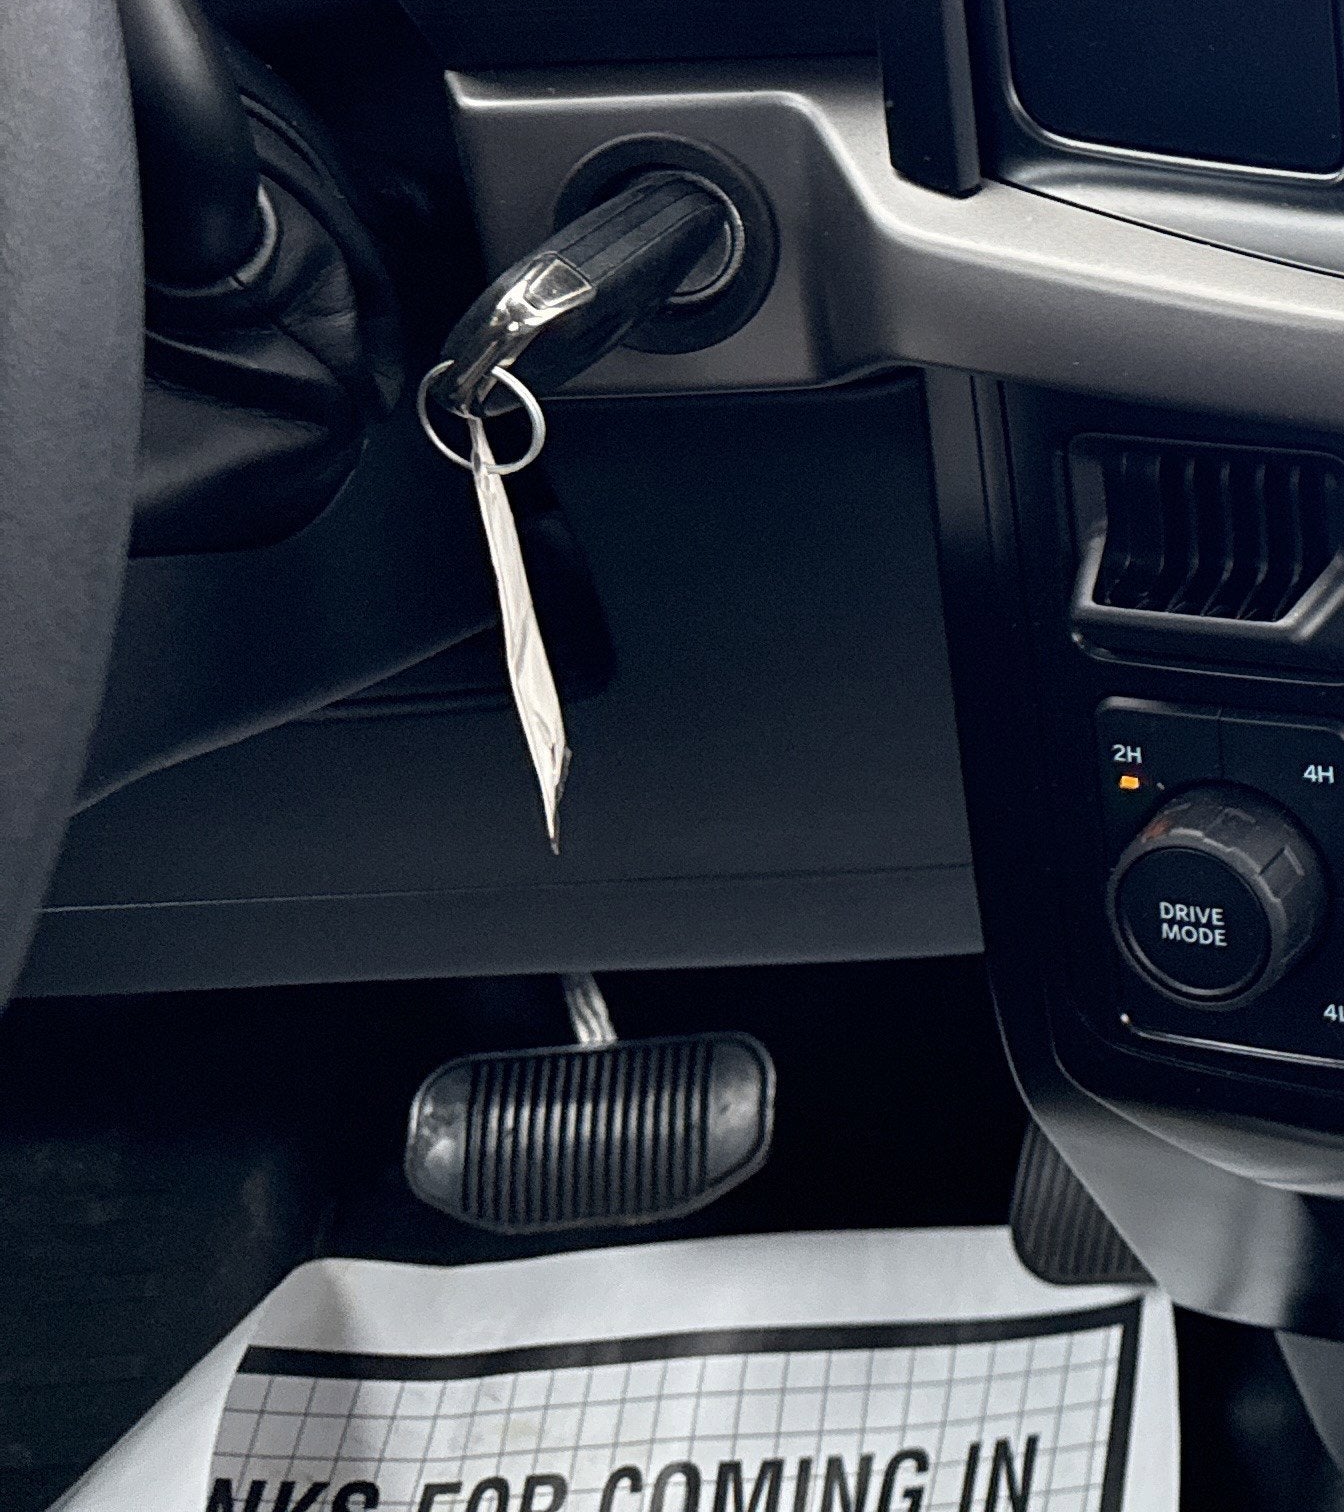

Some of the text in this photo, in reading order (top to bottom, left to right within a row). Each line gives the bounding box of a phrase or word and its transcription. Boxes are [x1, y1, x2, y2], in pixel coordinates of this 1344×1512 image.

[1113, 744, 1142, 763] 2H
[1304, 765, 1334, 783] 4H
[1160, 902, 1224, 925] DRIVE
[1162, 923, 1227, 946] MODE
[962, 1433, 1040, 1512] IN
